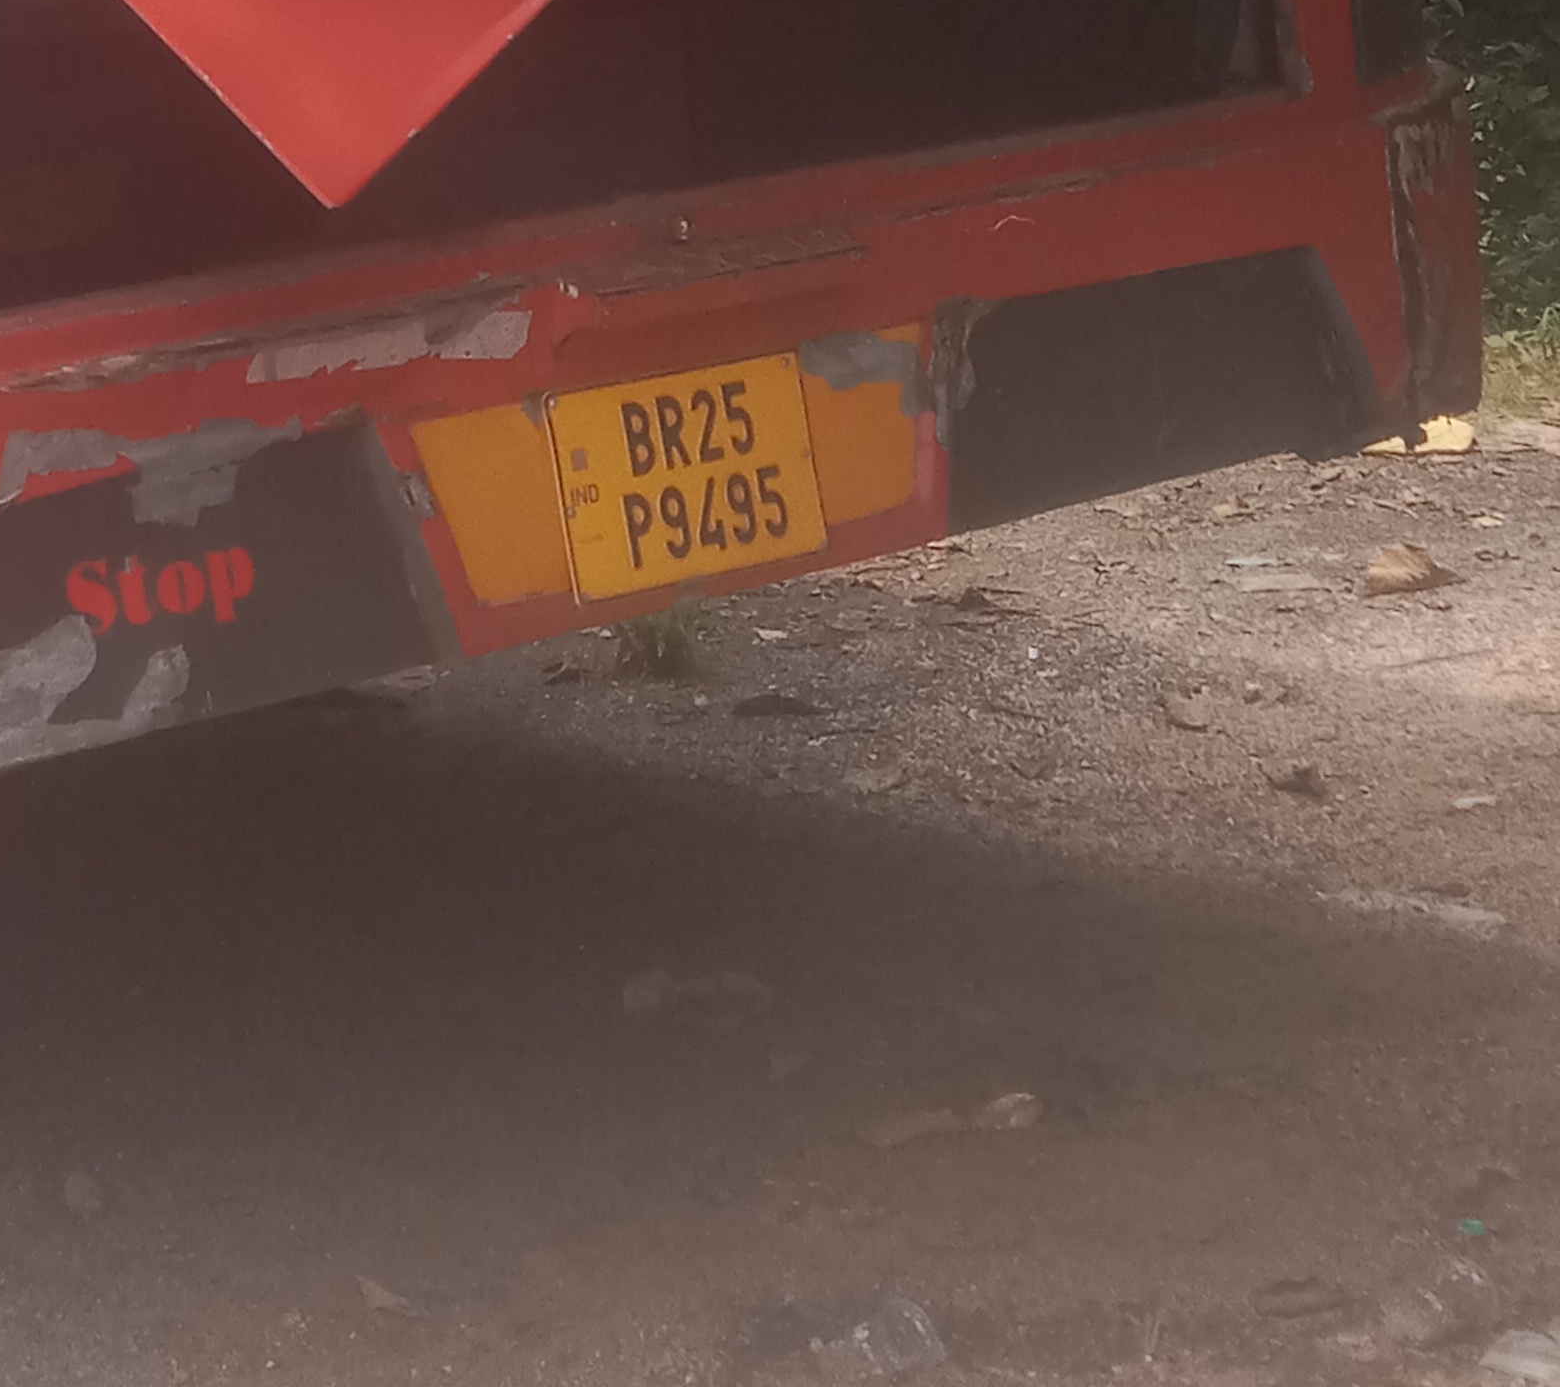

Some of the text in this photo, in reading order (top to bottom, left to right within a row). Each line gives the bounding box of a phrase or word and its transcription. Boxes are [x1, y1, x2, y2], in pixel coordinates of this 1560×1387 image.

[619, 380, 756, 478] BR25
[620, 464, 789, 570] P9495
[66, 545, 256, 636] Stop
